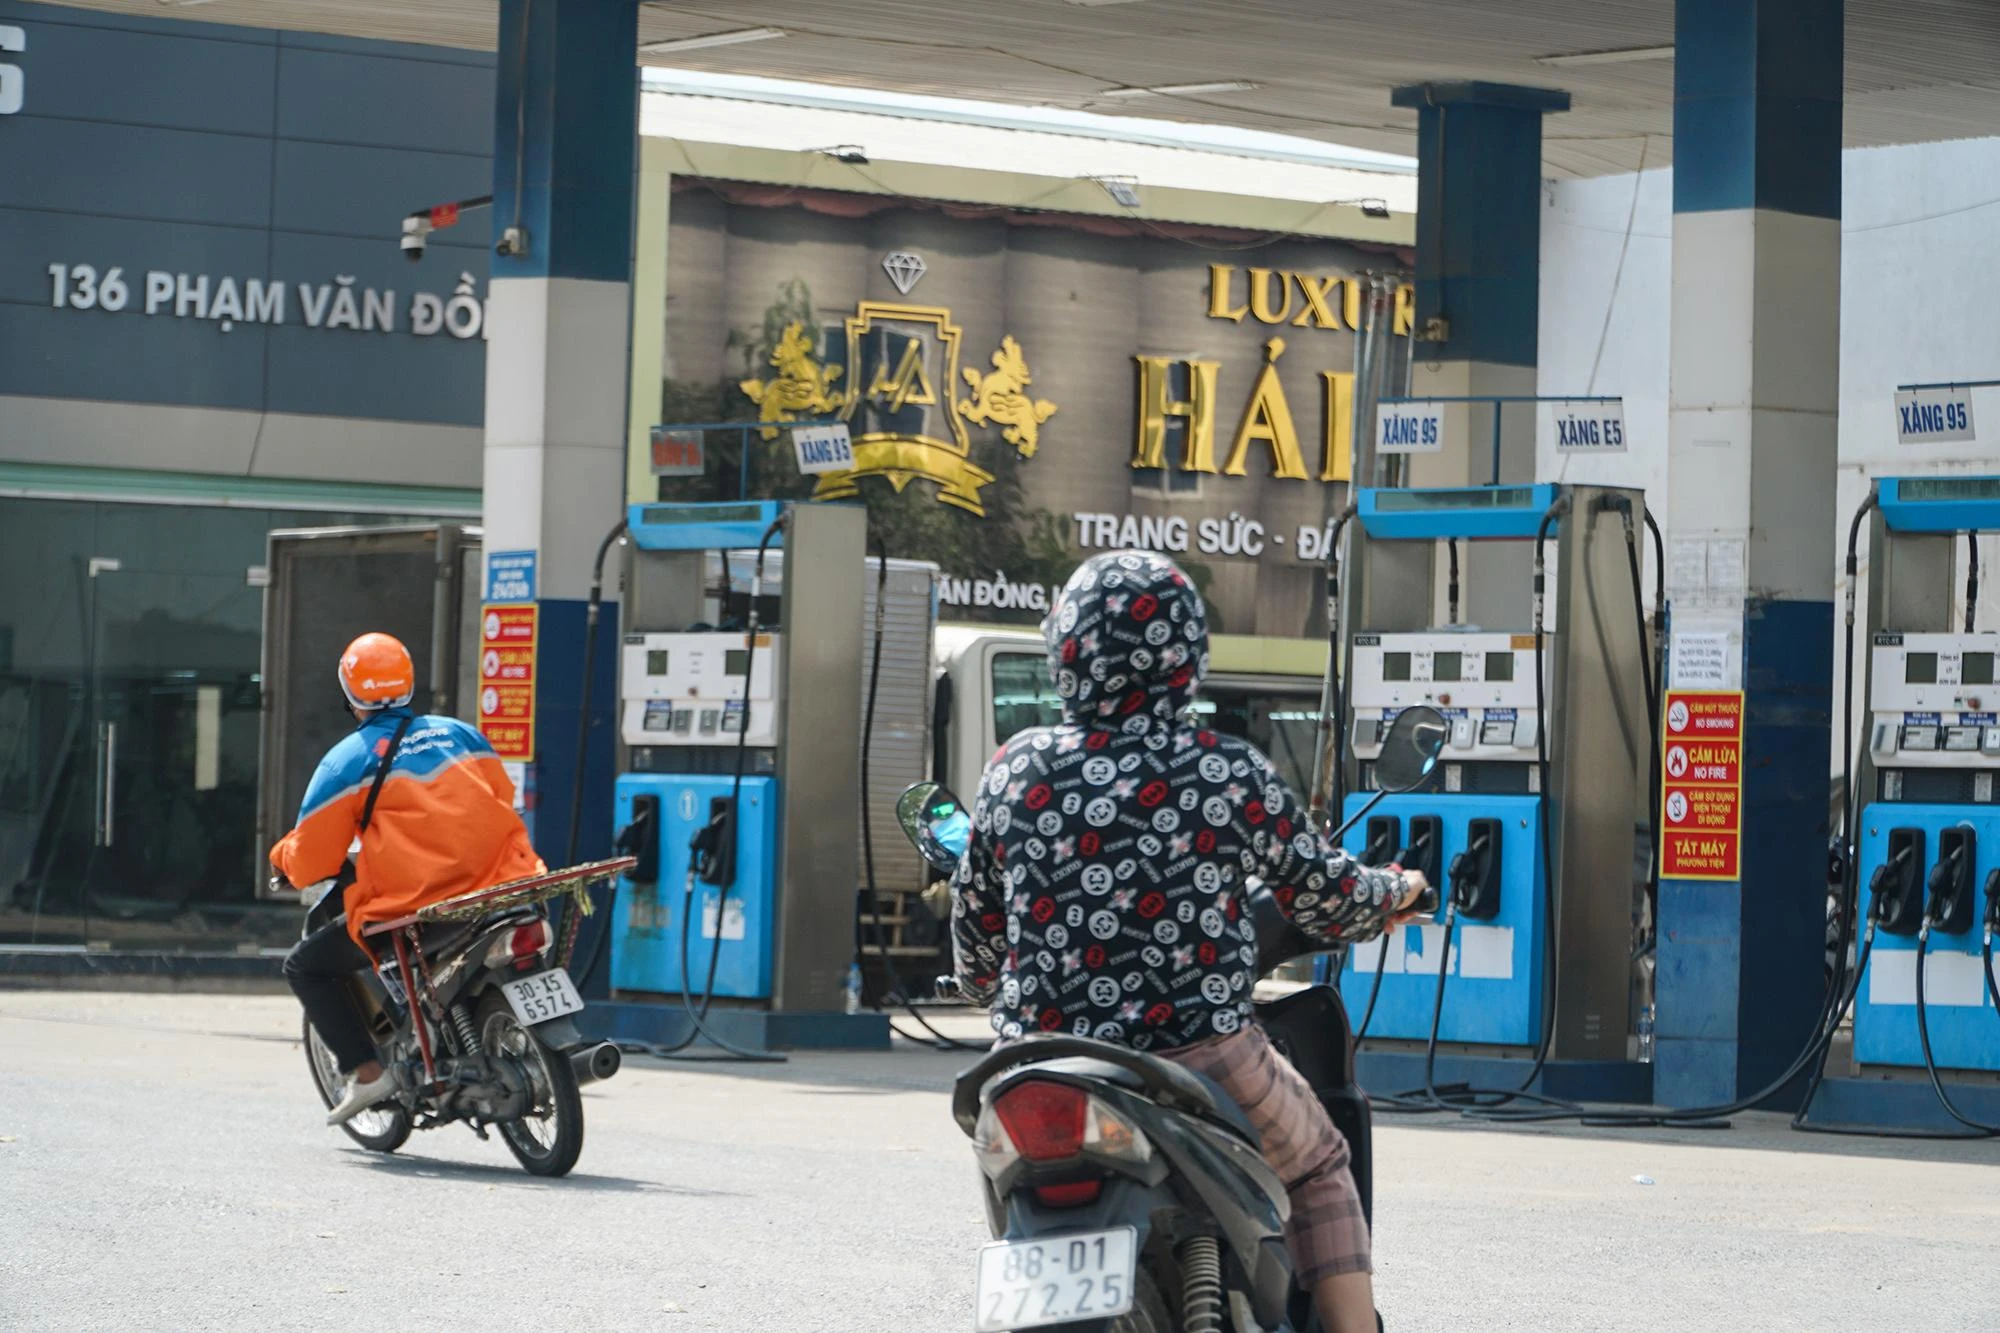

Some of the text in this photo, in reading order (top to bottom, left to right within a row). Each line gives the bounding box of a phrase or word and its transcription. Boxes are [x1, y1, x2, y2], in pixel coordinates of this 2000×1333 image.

[49, 263, 490, 339] 136 PHẠM VĂN ĐỒ
[1382, 413, 1438, 445] XĂNG 95
[1558, 414, 1622, 446] XĂNG E5
[1900, 400, 1967, 434] XĂNG 95
[833, 438, 851, 461] 95
[1074, 513, 1188, 551] TRANG
[1200, 511, 1264, 555] SỨC
[973, 569, 1050, 614] ĐỒNG,
[1695, 718, 1735, 729] NO SMOKING
[1694, 766, 1727, 780] NO FIRE
[1700, 838, 1727, 857] MÁY
[523, 992, 572, 1019] 6574
[984, 1274, 1122, 1327] 272.25
